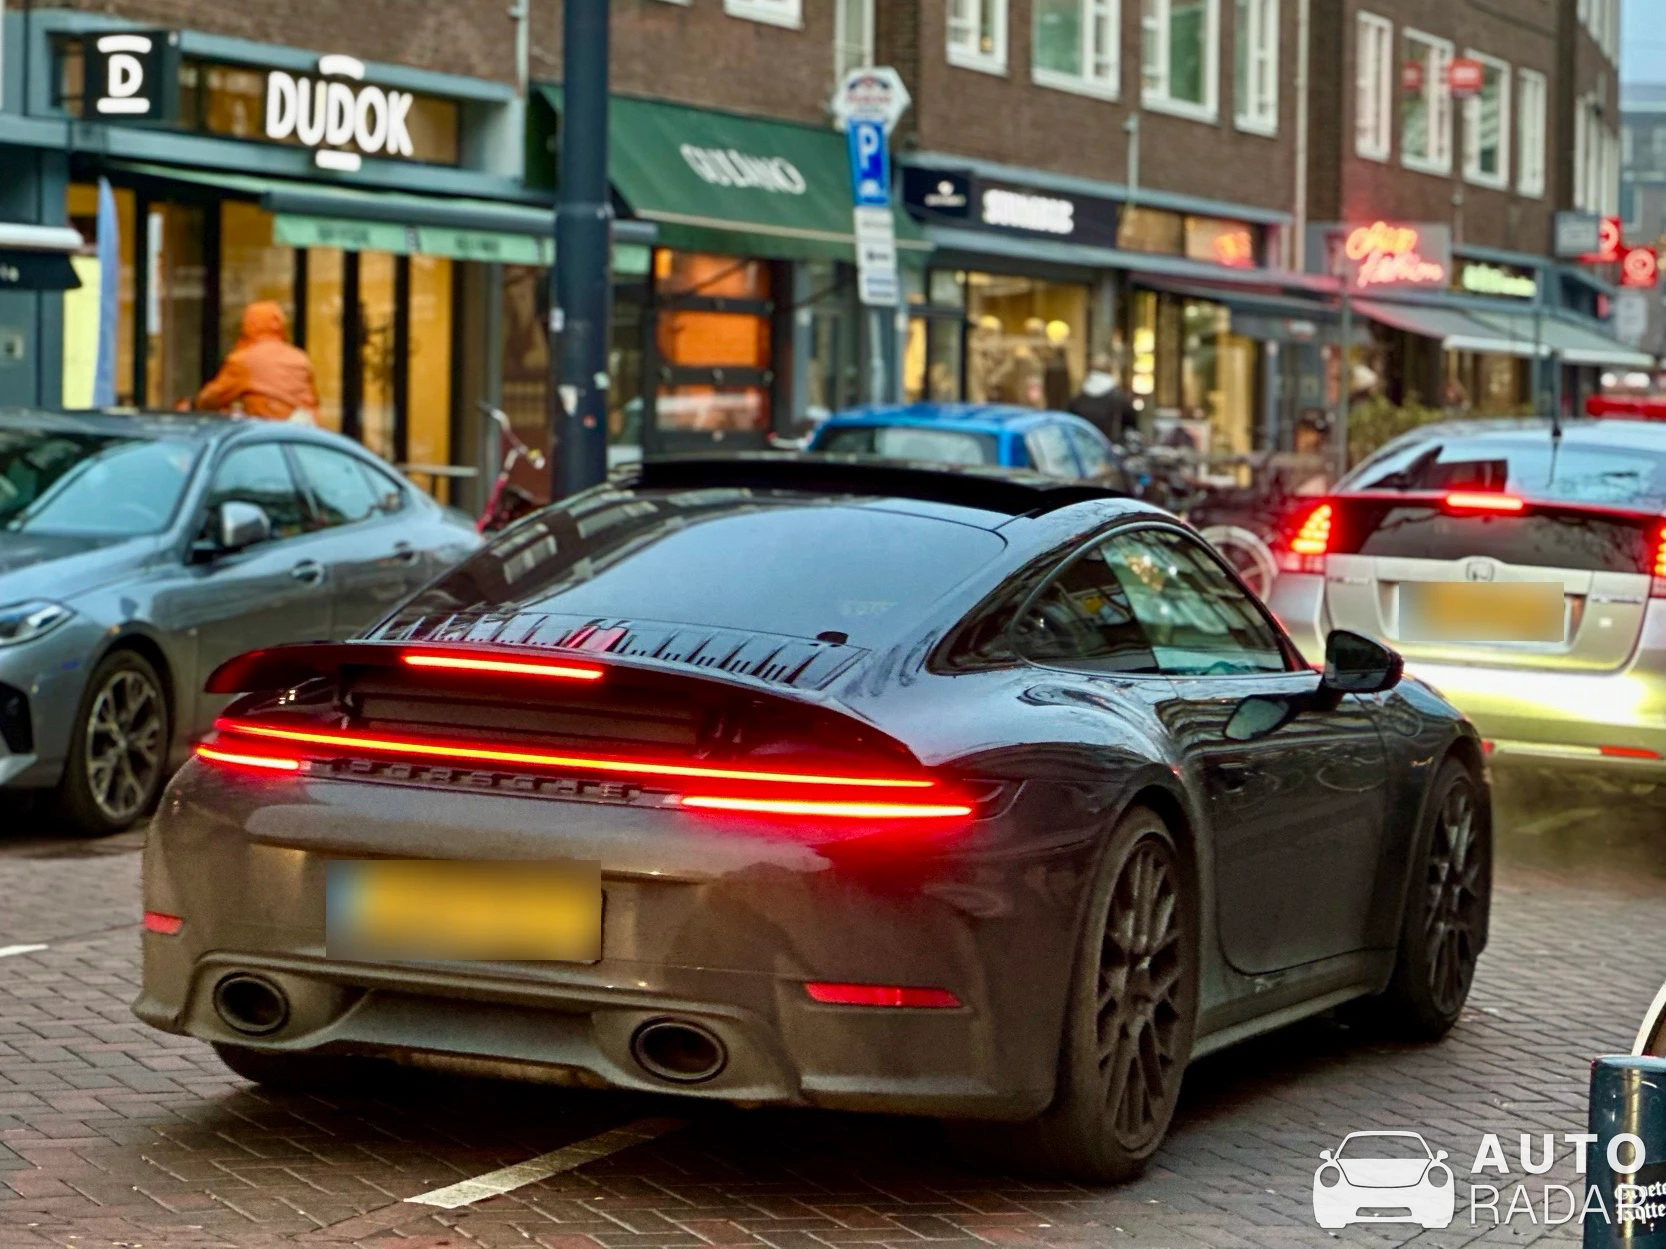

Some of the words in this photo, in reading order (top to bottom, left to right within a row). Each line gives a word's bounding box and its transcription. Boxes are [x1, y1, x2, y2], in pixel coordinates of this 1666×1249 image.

[108, 54, 144, 98] D
[265, 71, 414, 157] DUDOK
[857, 125, 879, 169] P
[348, 757, 625, 798] PORSCHE
